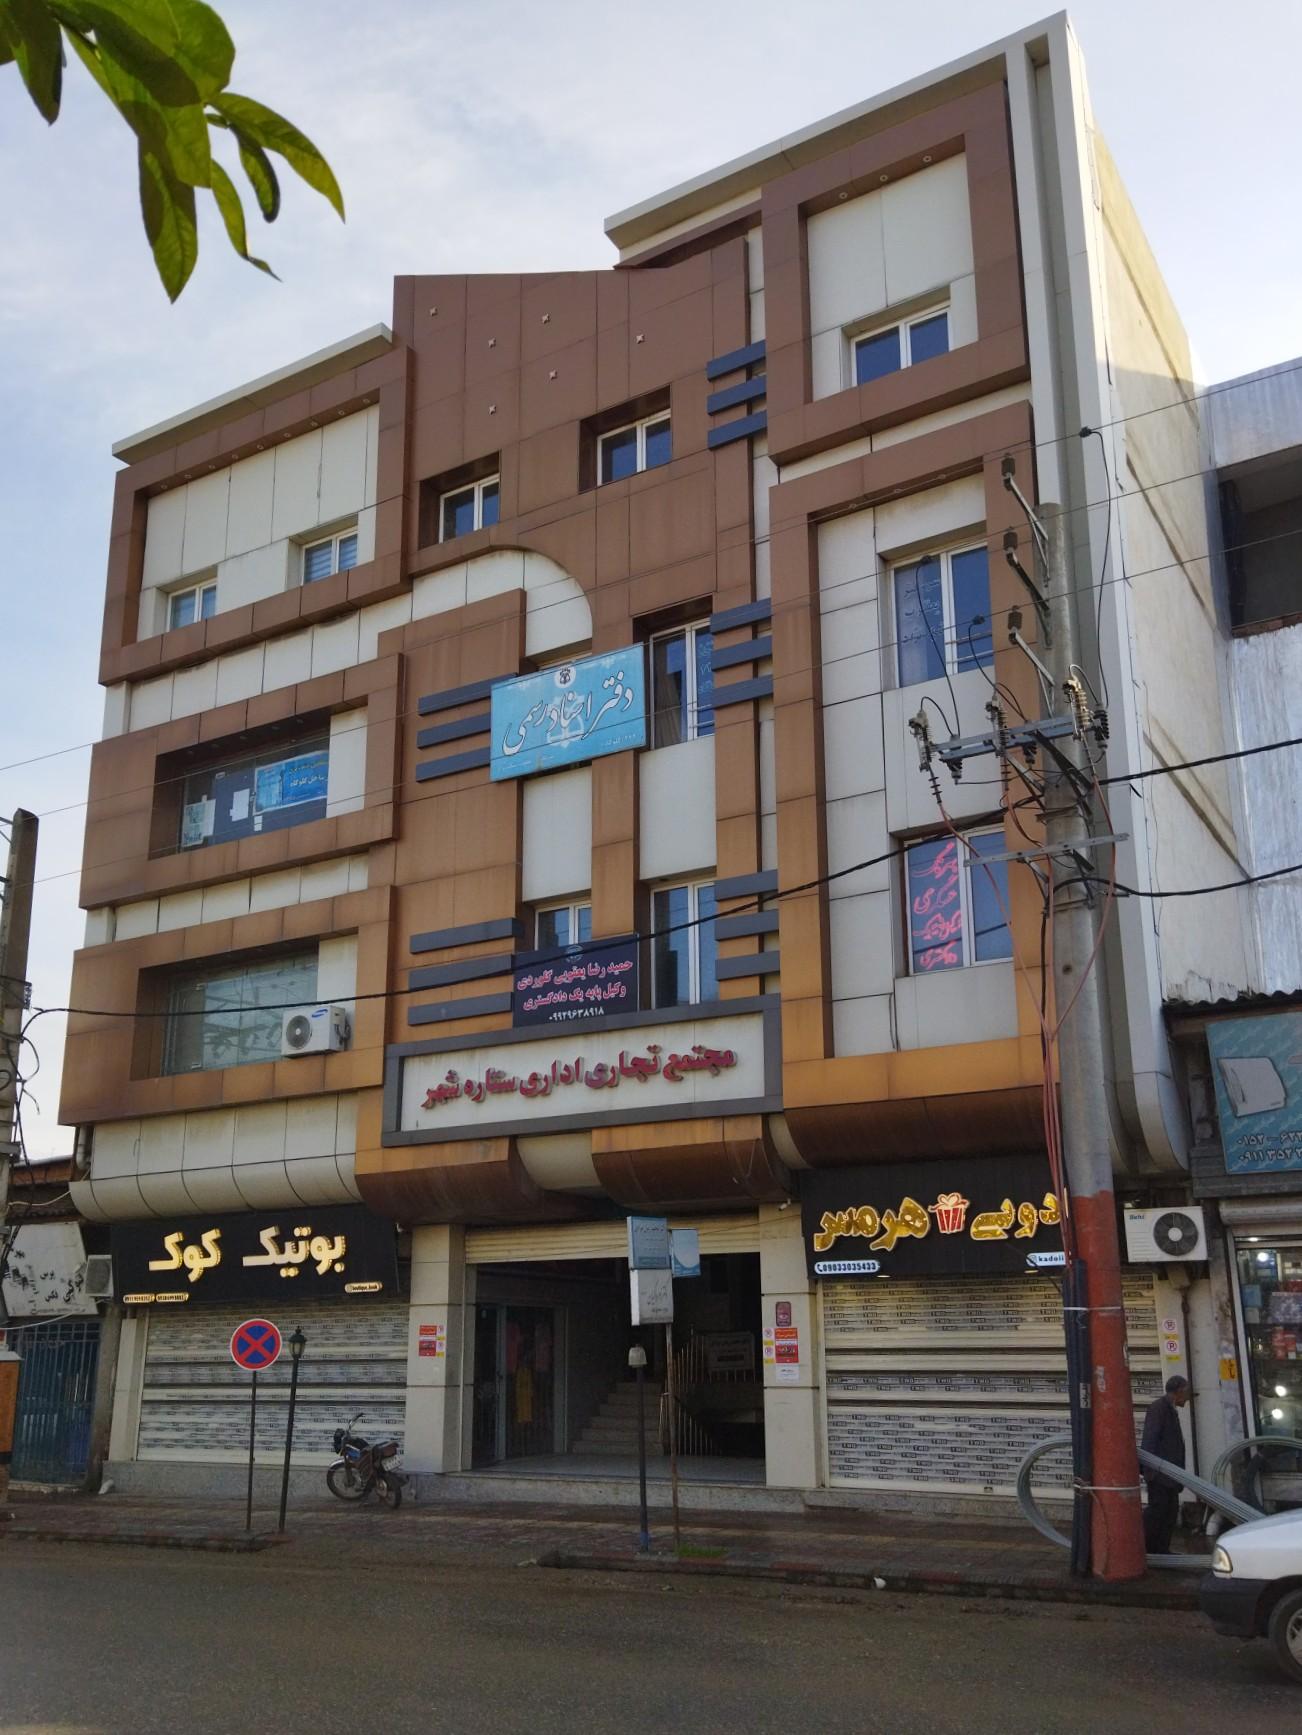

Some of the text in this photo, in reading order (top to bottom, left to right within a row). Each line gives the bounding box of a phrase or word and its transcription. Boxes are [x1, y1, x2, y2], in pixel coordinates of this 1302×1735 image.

[502, 671, 634, 756] دفتر اسناد رسمی
[523, 982, 626, 1011] وکیل پایه یک دادگستری
[421, 1045, 737, 1110] مجتمع تجاری اداری ستاره شهر
[814, 1196, 930, 1252] هرمس
[149, 1226, 347, 1283] بوتیک کوک
